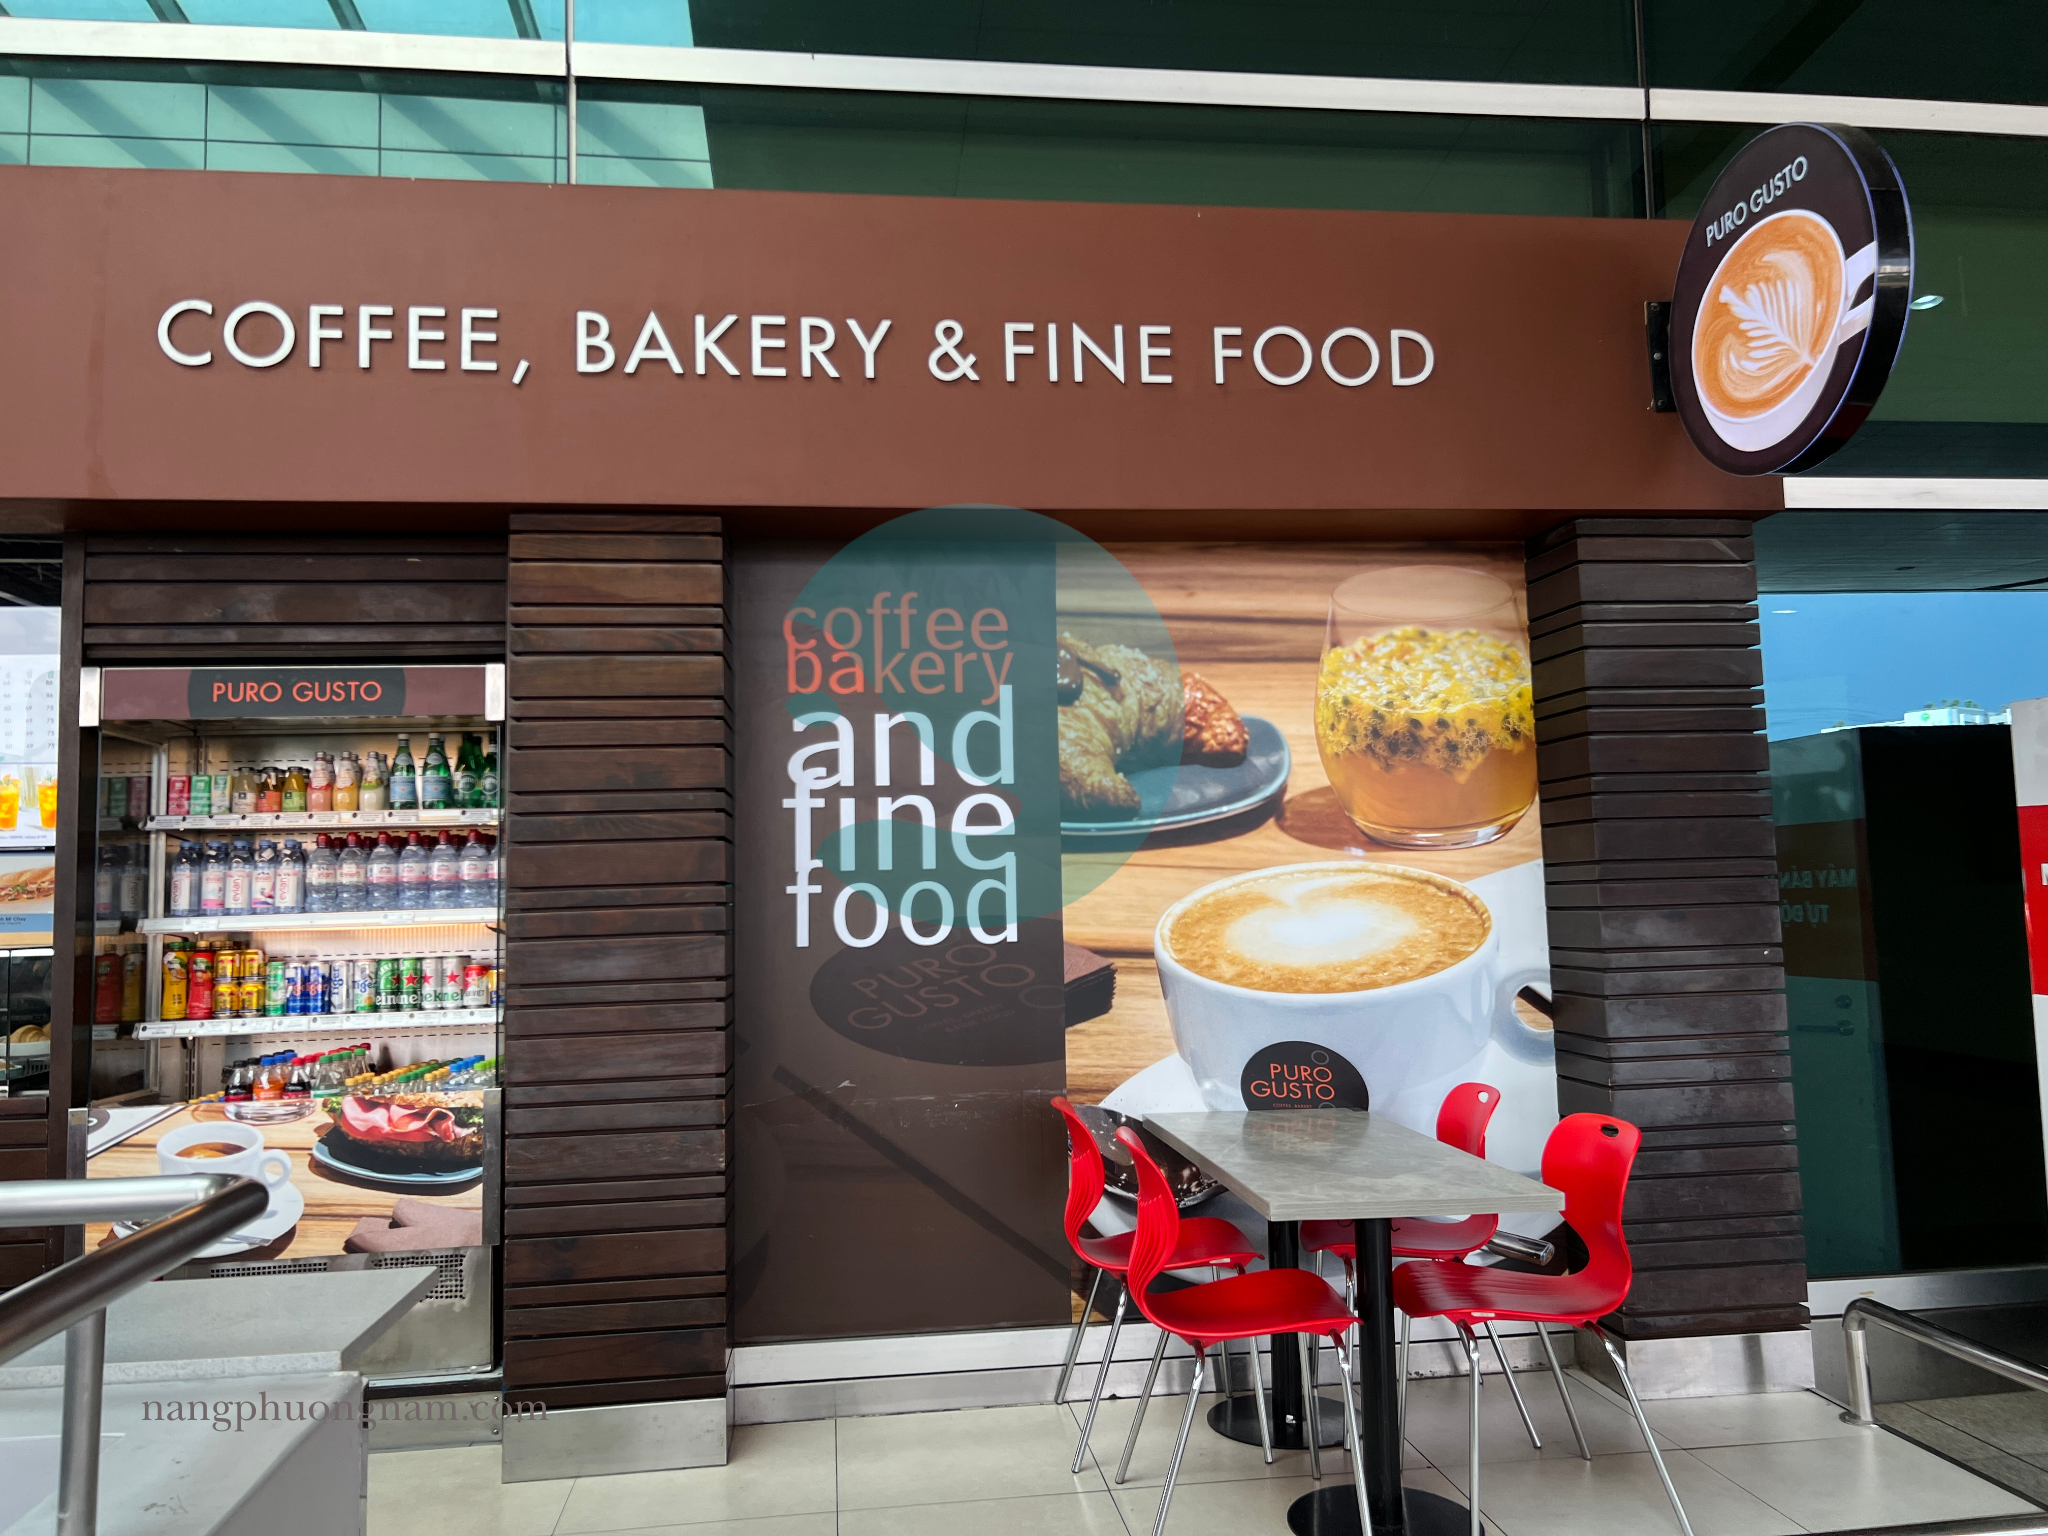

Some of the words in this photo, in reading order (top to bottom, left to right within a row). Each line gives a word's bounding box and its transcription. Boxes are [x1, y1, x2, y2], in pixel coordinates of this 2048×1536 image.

[1705, 200, 1748, 247] PURO
[1750, 155, 1808, 214] GUSTO
[157, 299, 529, 385] COFFEE,
[575, 309, 892, 380] BAKERY
[928, 318, 980, 382] &
[1004, 321, 1173, 385] FINE
[1213, 325, 1435, 387] FOOD
[783, 591, 1010, 651] coffee
[212, 681, 283, 703] PURO
[292, 680, 383, 703] GUSTO
[787, 641, 1014, 705] bakery
[787, 684, 1015, 789] and
[782, 766, 1016, 872] fine
[232, 878, 241, 903] evian
[278, 877, 288, 901] evian
[785, 851, 1018, 948] food
[333, 967, 344, 996] Tiger
[847, 963, 1036, 1030] GUSTO
[852, 944, 997, 999] PURO
[1250, 1080, 1336, 1100] GUSTO
[1270, 1063, 1333, 1083] PURO
